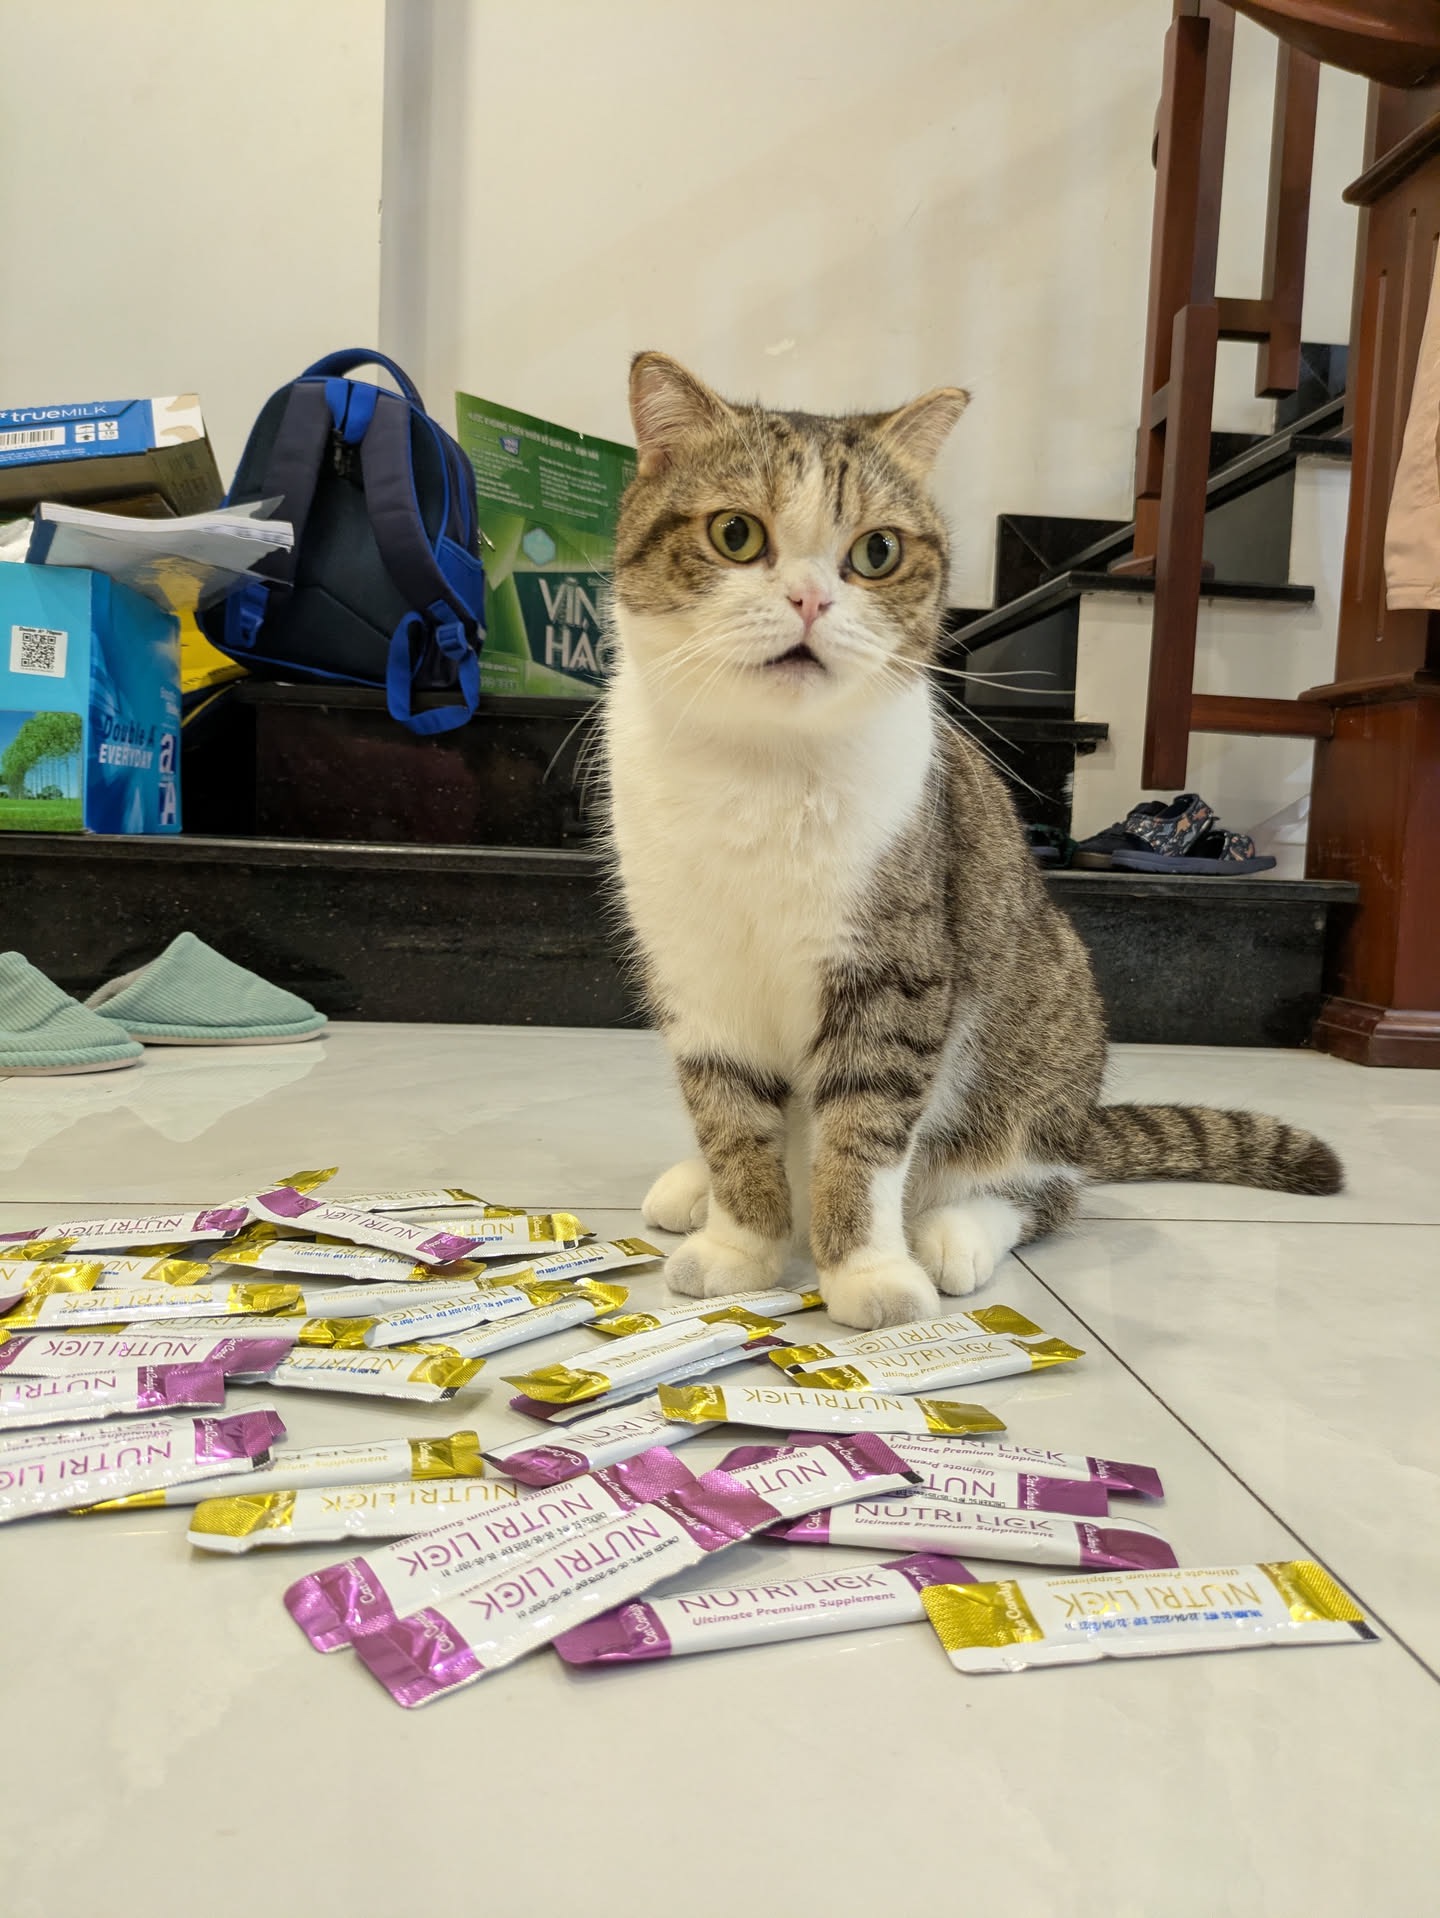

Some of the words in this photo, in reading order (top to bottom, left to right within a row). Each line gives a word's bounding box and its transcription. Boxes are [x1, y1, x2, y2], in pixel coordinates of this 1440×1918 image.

[101, 713, 145, 746] Double
[99, 743, 153, 769] EVERYDAY
[110, 1217, 183, 1232] NUTRI
[316, 1208, 360, 1223] LICK
[56, 1223, 105, 1238] LICK
[359, 1218, 420, 1240] NUTRI
[546, 1246, 609, 1264] NUTRI
[432, 1290, 509, 1311] NUTRI
[670, 1305, 704, 1316] Ultimate
[706, 1298, 739, 1309] Premium
[898, 1321, 969, 1345] NUTRI
[40, 1340, 105, 1357] LICK
[108, 1341, 197, 1357] NUTRI
[866, 1347, 946, 1369] NUTRI
[947, 1341, 1004, 1356] LICK
[882, 1371, 919, 1379] Ultimate
[15, 1376, 117, 1399] NUTRI
[741, 1388, 807, 1405] LICK
[815, 1392, 904, 1412] NUTRI
[566, 1419, 643, 1444] NUTRI
[591, 1435, 628, 1448] Ultimate
[60, 1440, 171, 1479] NUTRI
[761, 1451, 809, 1467] Ultimate
[838, 1449, 866, 1476] Candy's
[891, 1443, 940, 1454] Ultimate
[943, 1447, 995, 1457] Premium
[997, 1452, 1068, 1468] Supplement
[952, 1464, 995, 1476] Ultimate
[1026, 1473, 1040, 1489] Cat
[411, 1483, 519, 1505] NUTRI
[523, 1481, 574, 1501] Ultimate
[597, 1468, 610, 1483] Cat
[606, 1480, 633, 1507] Candy's
[320, 1492, 396, 1513] LICK
[466, 1499, 521, 1522] Premium
[1026, 1488, 1040, 1511] Candy's
[484, 1492, 594, 1544] NUTRI
[659, 1495, 672, 1508] Cat
[669, 1505, 700, 1530] Candy's
[854, 1502, 962, 1523] NUTRI
[976, 1513, 1055, 1531] LICK
[855, 1516, 911, 1529] Ultimate
[913, 1520, 974, 1532] Premium
[975, 1524, 1055, 1539] Supplement
[396, 1532, 481, 1577] LICK
[553, 1518, 662, 1579] NUTRI
[1045, 1574, 1122, 1588] Supplement
[1125, 1570, 1181, 1582] Premium
[1185, 1568, 1240, 1580] Ultimate
[467, 1566, 555, 1621] LICK
[677, 1583, 799, 1613] NUTRI
[803, 1572, 888, 1595] LICK
[1145, 1582, 1263, 1612] NUTRI
[691, 1609, 753, 1626] Ultimate
[755, 1601, 816, 1617] Premium
[818, 1591, 897, 1609] Supplement
[1052, 1589, 1138, 1619] LICK
[637, 1624, 658, 1646] Cat
